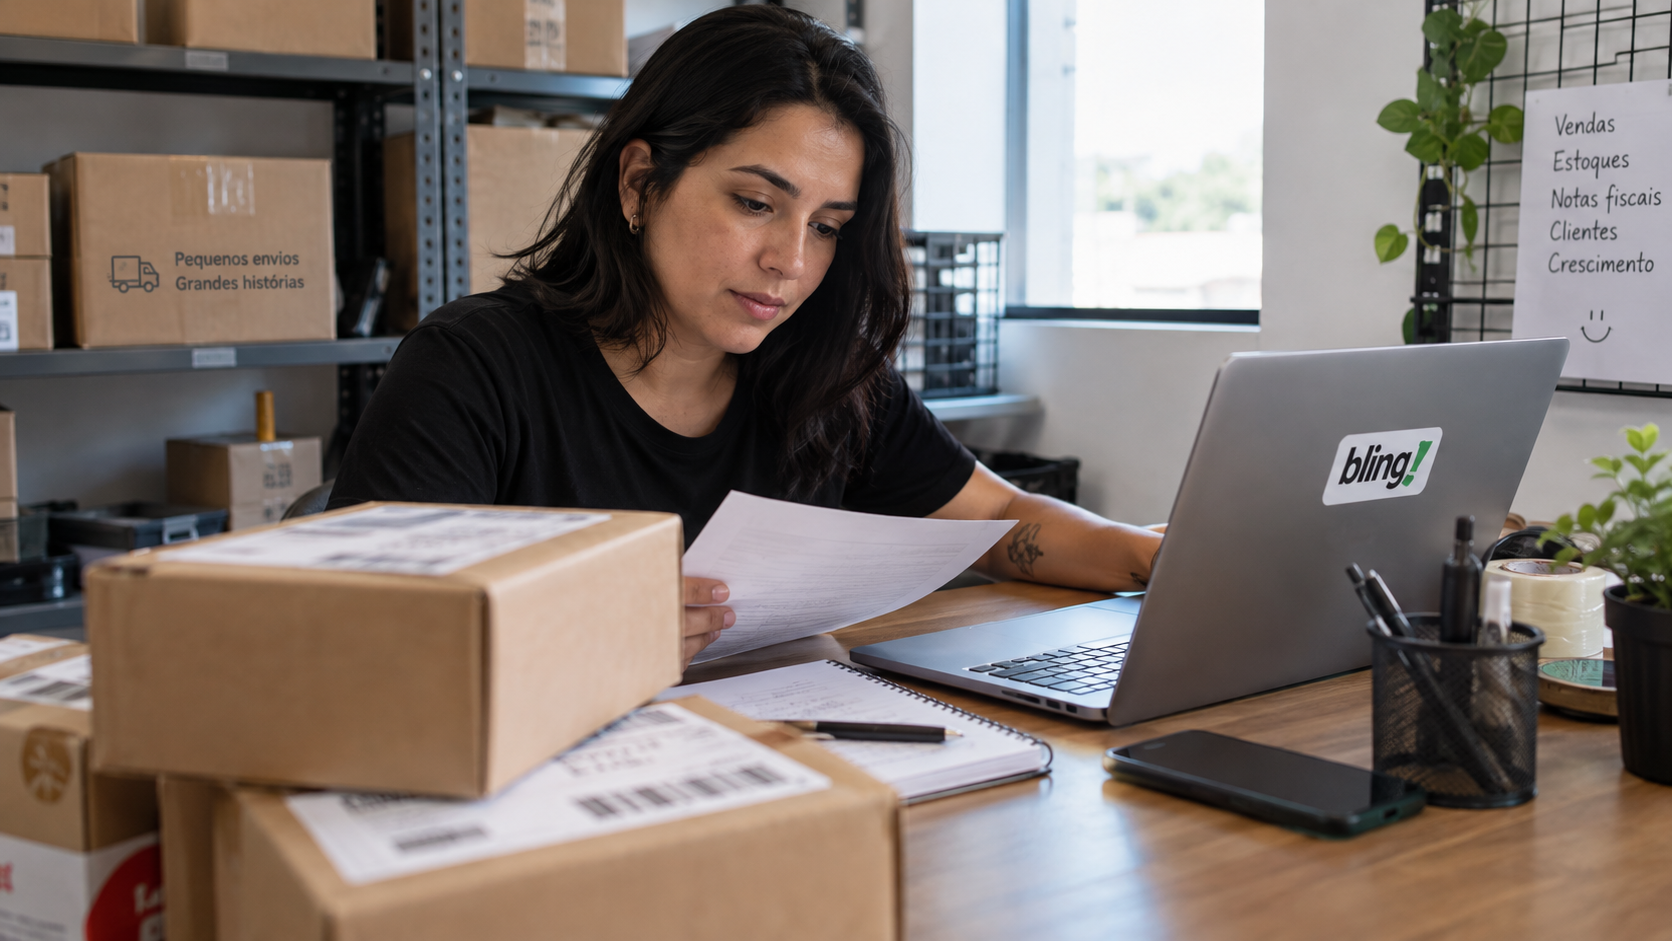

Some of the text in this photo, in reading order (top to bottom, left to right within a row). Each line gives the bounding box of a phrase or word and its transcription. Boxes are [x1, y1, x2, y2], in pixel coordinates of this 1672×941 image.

[1555, 111, 1616, 136] Vendas
[1553, 149, 1630, 179] Estoques
[1551, 184, 1662, 214] Notas fiscais
[1550, 219, 1618, 241] Clientes
[175, 251, 300, 270] Pequenos envios
[1548, 251, 1655, 273] Crescimento
[175, 274, 305, 291] Grandes histórias
[1338, 440, 1433, 490] bling!
